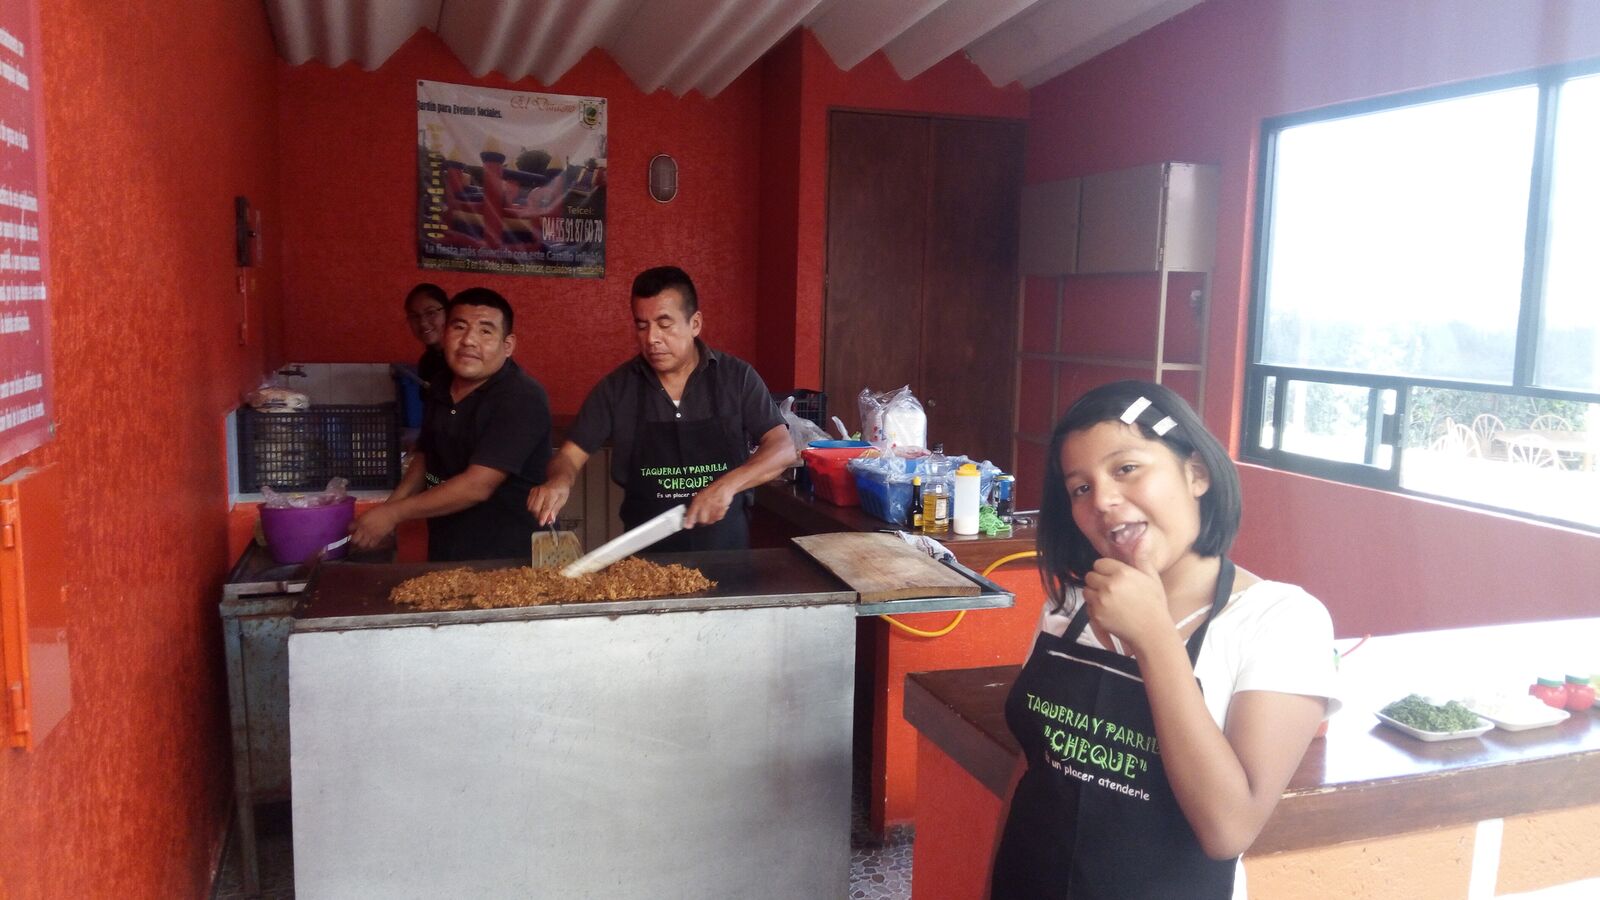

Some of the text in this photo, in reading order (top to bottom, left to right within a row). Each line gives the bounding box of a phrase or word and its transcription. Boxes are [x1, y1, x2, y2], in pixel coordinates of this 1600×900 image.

[437, 104, 452, 114] para
[453, 104, 476, 116] Eventos
[640, 462, 728, 477] TAQUERIA Y PARRILLA
[1026, 692, 1161, 755] TAQUERIA Y PARRIL
[1051, 760, 1062, 770] un
[1064, 765, 1095, 783] placer
[1098, 777, 1150, 801] atenderle
